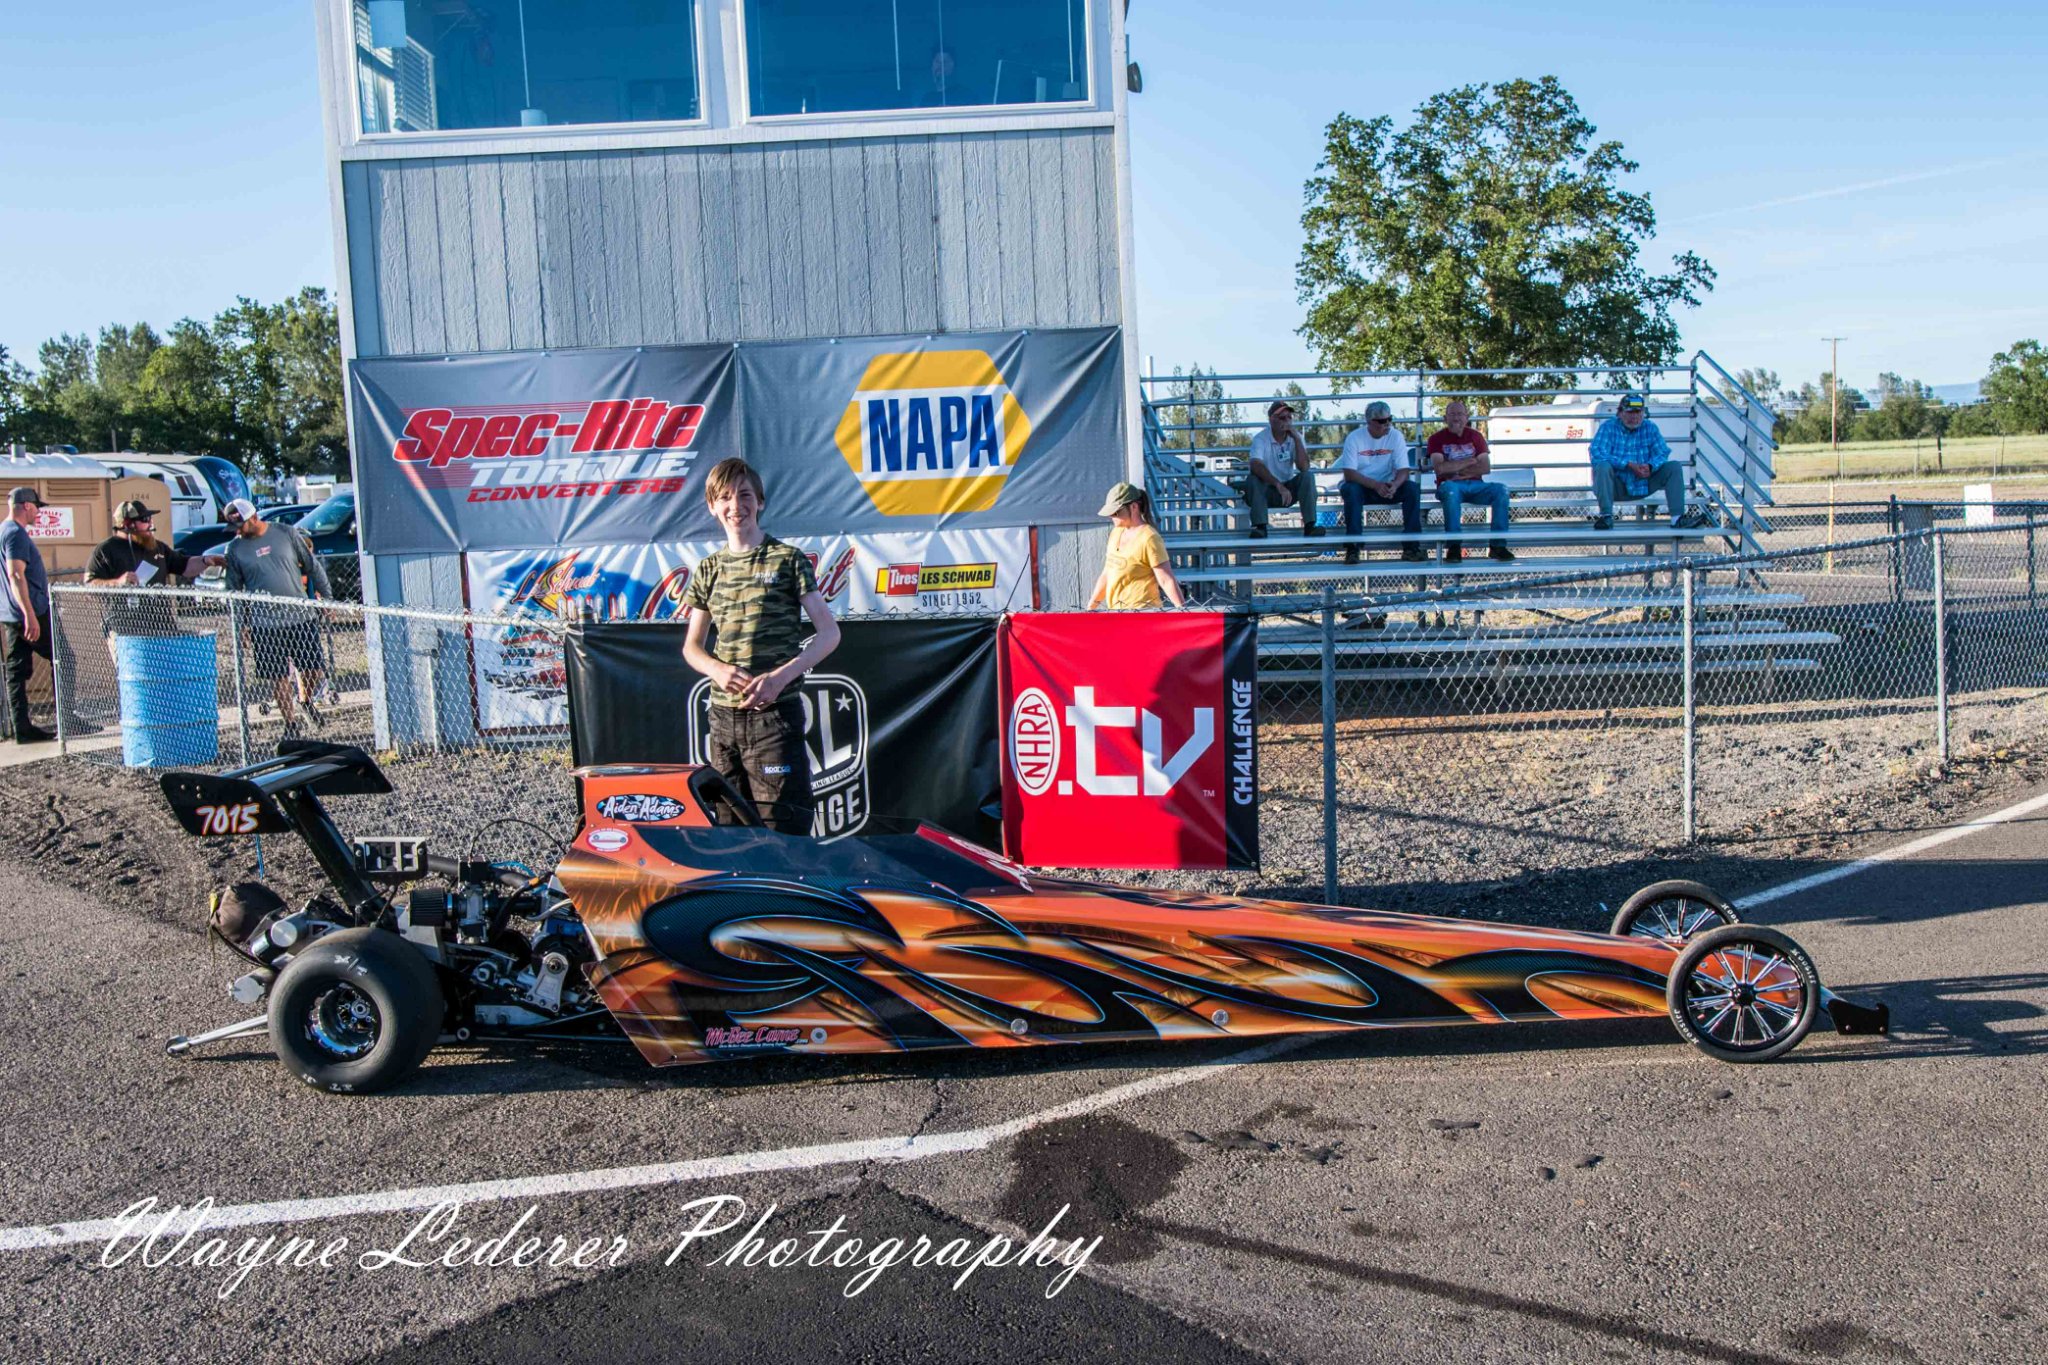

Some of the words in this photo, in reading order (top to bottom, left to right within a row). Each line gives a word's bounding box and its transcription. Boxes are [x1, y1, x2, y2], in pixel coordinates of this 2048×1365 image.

[393, 397, 706, 468] Spec-Rite
[868, 394, 1000, 473] NAPA
[469, 451, 699, 488] TORQUE
[466, 478, 687, 503] CONVERTERS
[28, 529, 71, 537] 43-0657
[890, 569, 918, 588] Tires
[921, 572, 940, 585] LES
[942, 570, 991, 584] SCHWAB
[922, 593, 951, 607] SINCE
[955, 592, 982, 605] 1952
[1017, 703, 1051, 779] NHRA
[1058, 686, 1215, 796] .tv
[1232, 678, 1253, 806] CHALLENGE
[196, 803, 260, 836] 7015
[603, 795, 637, 821] Aiden
[639, 796, 681, 821] Adams
[811, 783, 862, 838] NGE
[1720, 903, 1740, 924] HOOS
